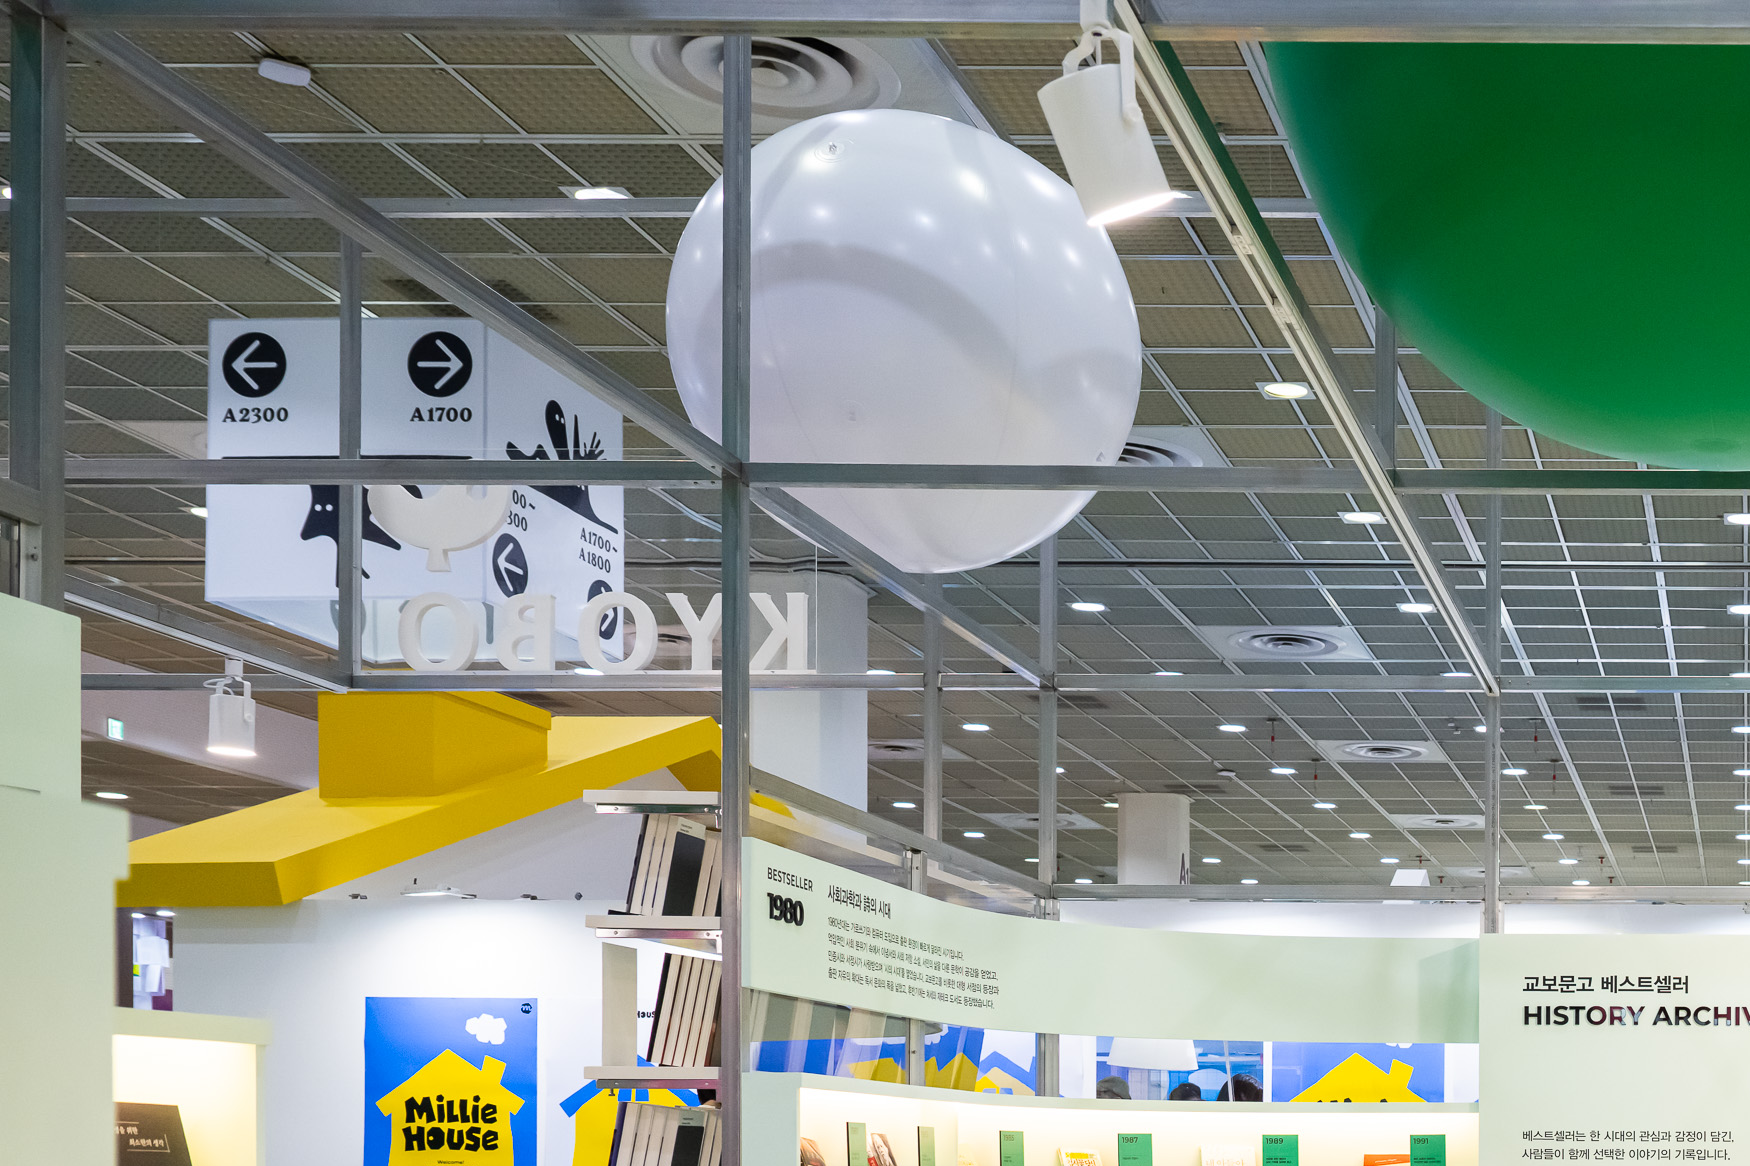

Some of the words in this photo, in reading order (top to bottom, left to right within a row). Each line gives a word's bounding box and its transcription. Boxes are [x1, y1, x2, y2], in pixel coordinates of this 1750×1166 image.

[222, 406, 289, 424] A2300
[410, 406, 472, 423] A1700
[579, 547, 611, 574] A1800
[767, 866, 814, 892] BESTSELLER
[767, 892, 805, 927] 1980
[828, 885, 862, 910] 사회과학과
[879, 901, 890, 919] 시대
[1523, 976, 1594, 994] 교보문고
[1601, 976, 1688, 994] 베스트셀러
[1524, 1006, 1645, 1025] HISTORY
[1121, 1136, 1139, 1144] 1987
[1265, 1137, 1284, 1145] 1989
[1413, 1137, 1429, 1145] 1991
[1523, 1130, 1586, 1141] 베스트셀러는
[1590, 1130, 1600, 1141] 한
[1604, 1131, 1635, 1142] 시대의
[1639, 1131, 1671, 1142] 관심과
[1675, 1131, 1706, 1142] 감정이
[1711, 1131, 1734, 1142] 담긴,
[1522, 1149, 1564, 1160] 사람들이
[1568, 1149, 1589, 1160] 함께
[1593, 1149, 1625, 1160] 선택한
[1629, 1149, 1670, 1160] 이야기의
[1675, 1149, 1730, 1160] 기록입니다.
